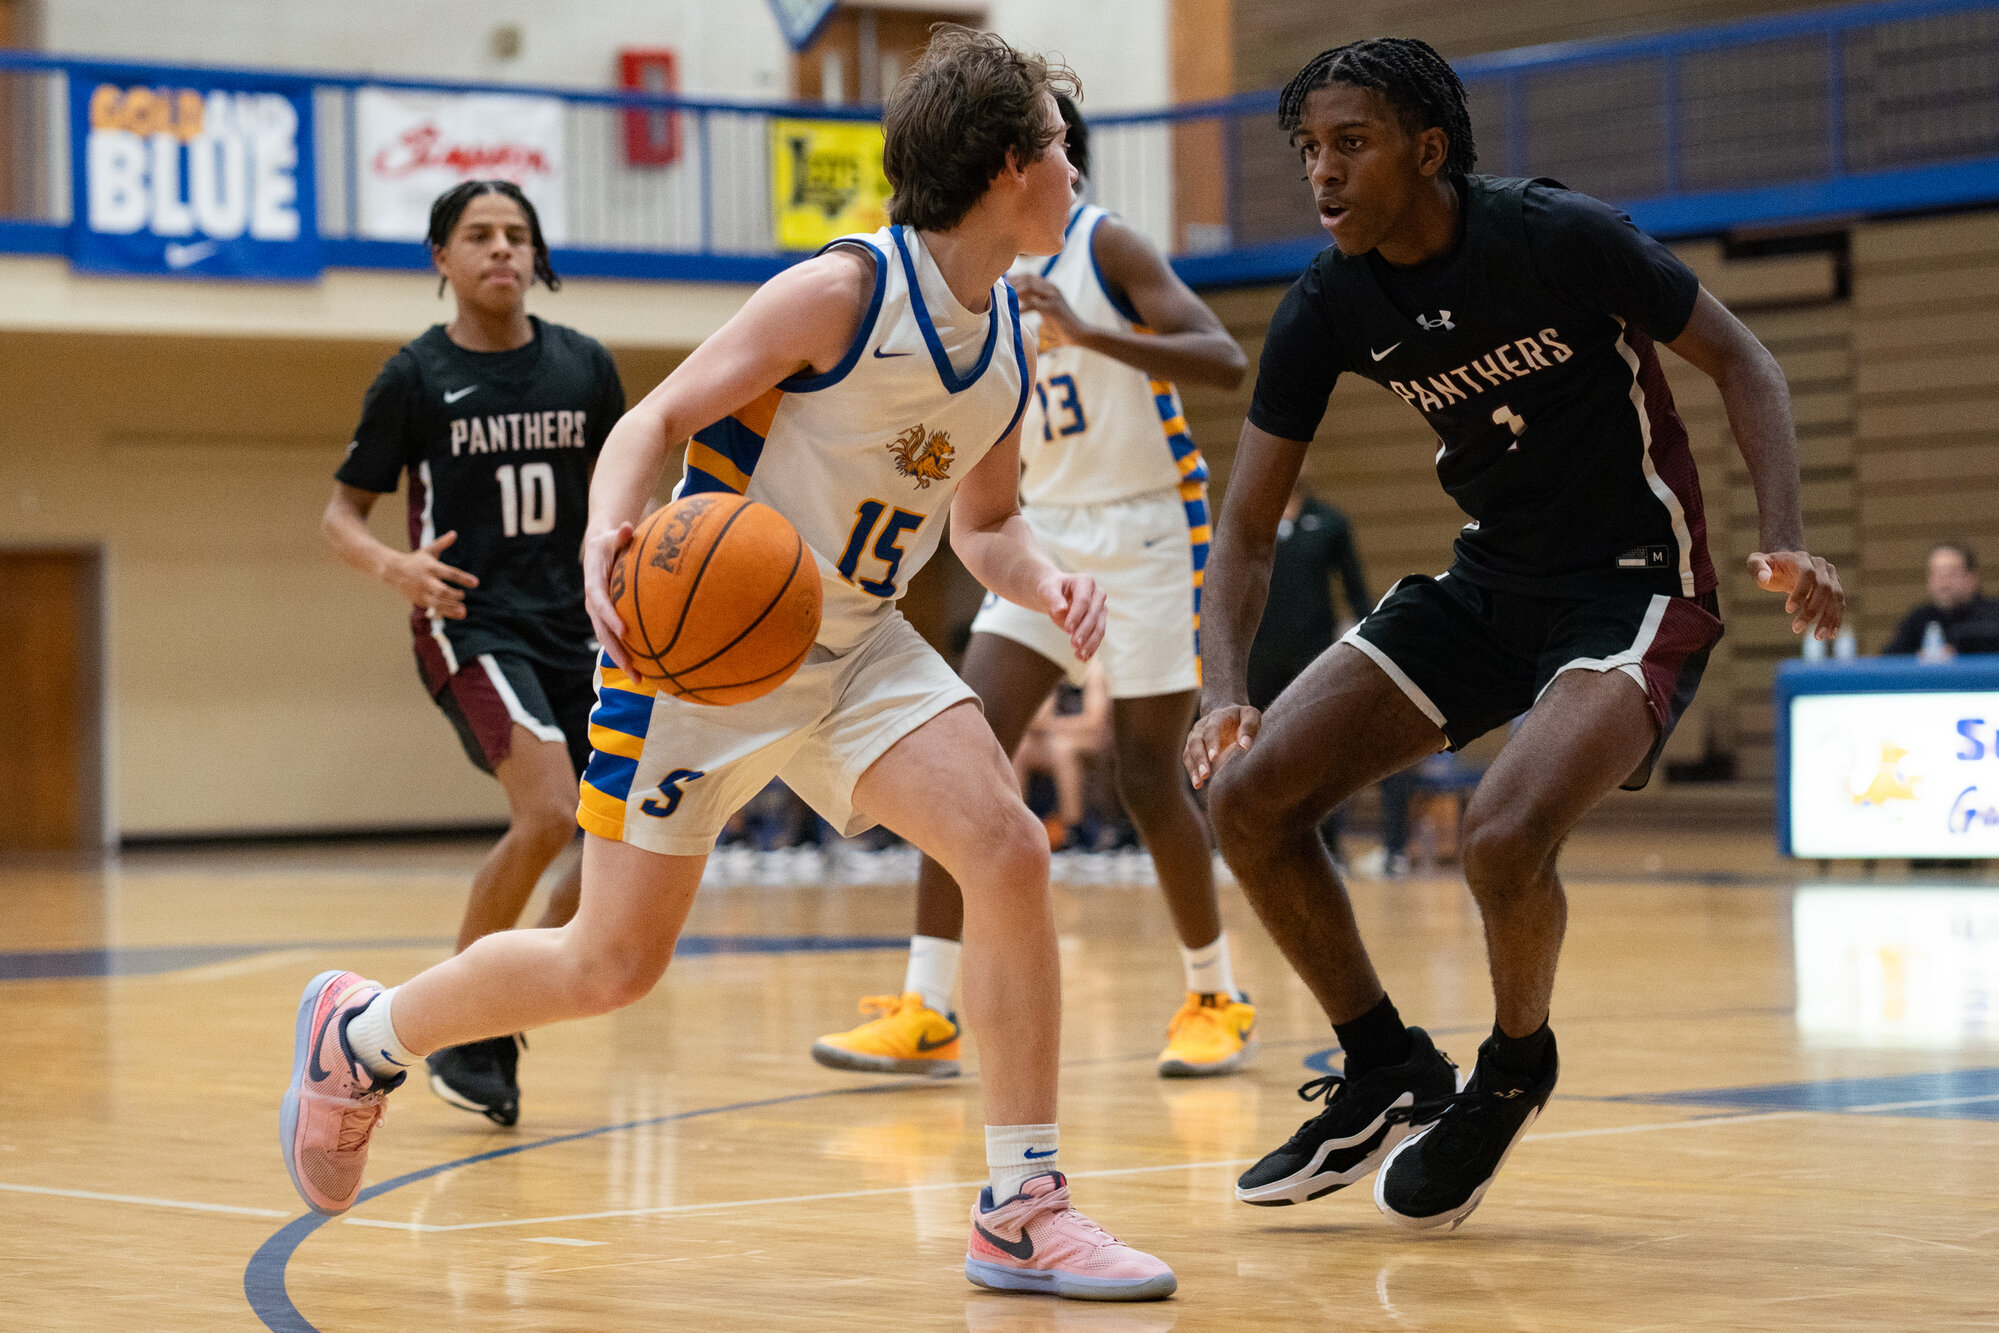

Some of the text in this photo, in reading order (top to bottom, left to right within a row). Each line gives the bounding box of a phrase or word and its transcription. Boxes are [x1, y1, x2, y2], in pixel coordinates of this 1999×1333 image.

[87, 132, 300, 241] BLUE
[1390, 328, 1574, 413] PANTHERS
[450, 410, 586, 456] PANTHERS
[495, 462, 556, 538] 10
[650, 498, 717, 574] NCAA
[836, 498, 927, 598] 15
[1652, 551, 1663, 562] M
[639, 768, 705, 819] S
